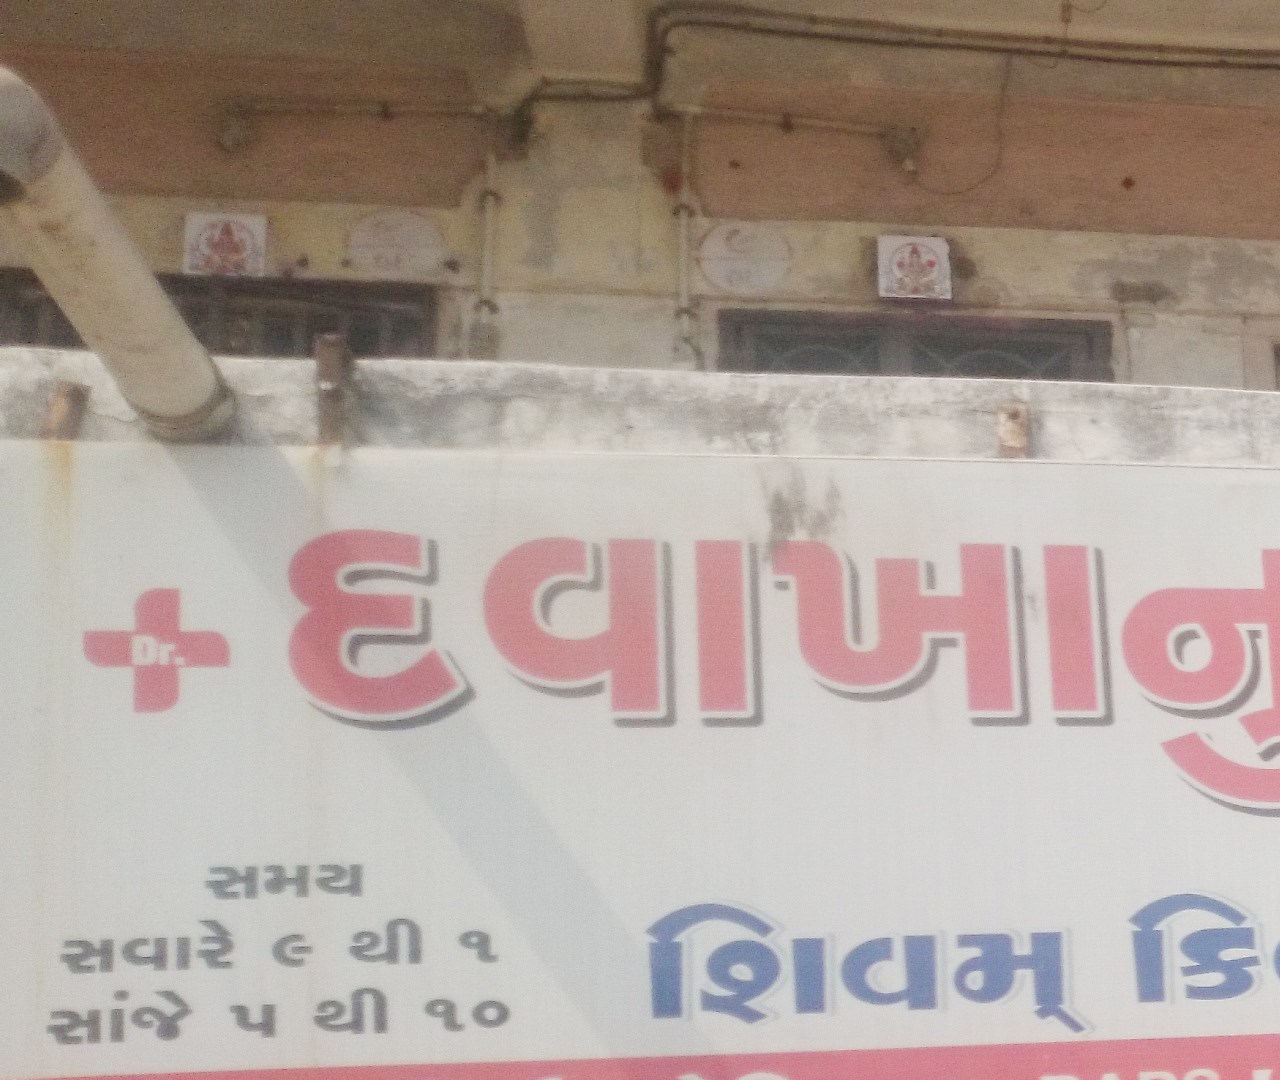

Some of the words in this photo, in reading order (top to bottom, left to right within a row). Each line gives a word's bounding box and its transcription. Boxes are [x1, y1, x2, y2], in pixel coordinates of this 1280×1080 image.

[205, 863, 364, 901] સમય
[58, 920, 235, 975] સવારે
[347, 918, 422, 965] થી
[458, 929, 498, 963] ૧
[645, 903, 1092, 1034] શિવમ્
[46, 990, 194, 1046] સાંજે
[313, 987, 389, 1034] થી
[424, 997, 511, 1032] ૧૦
